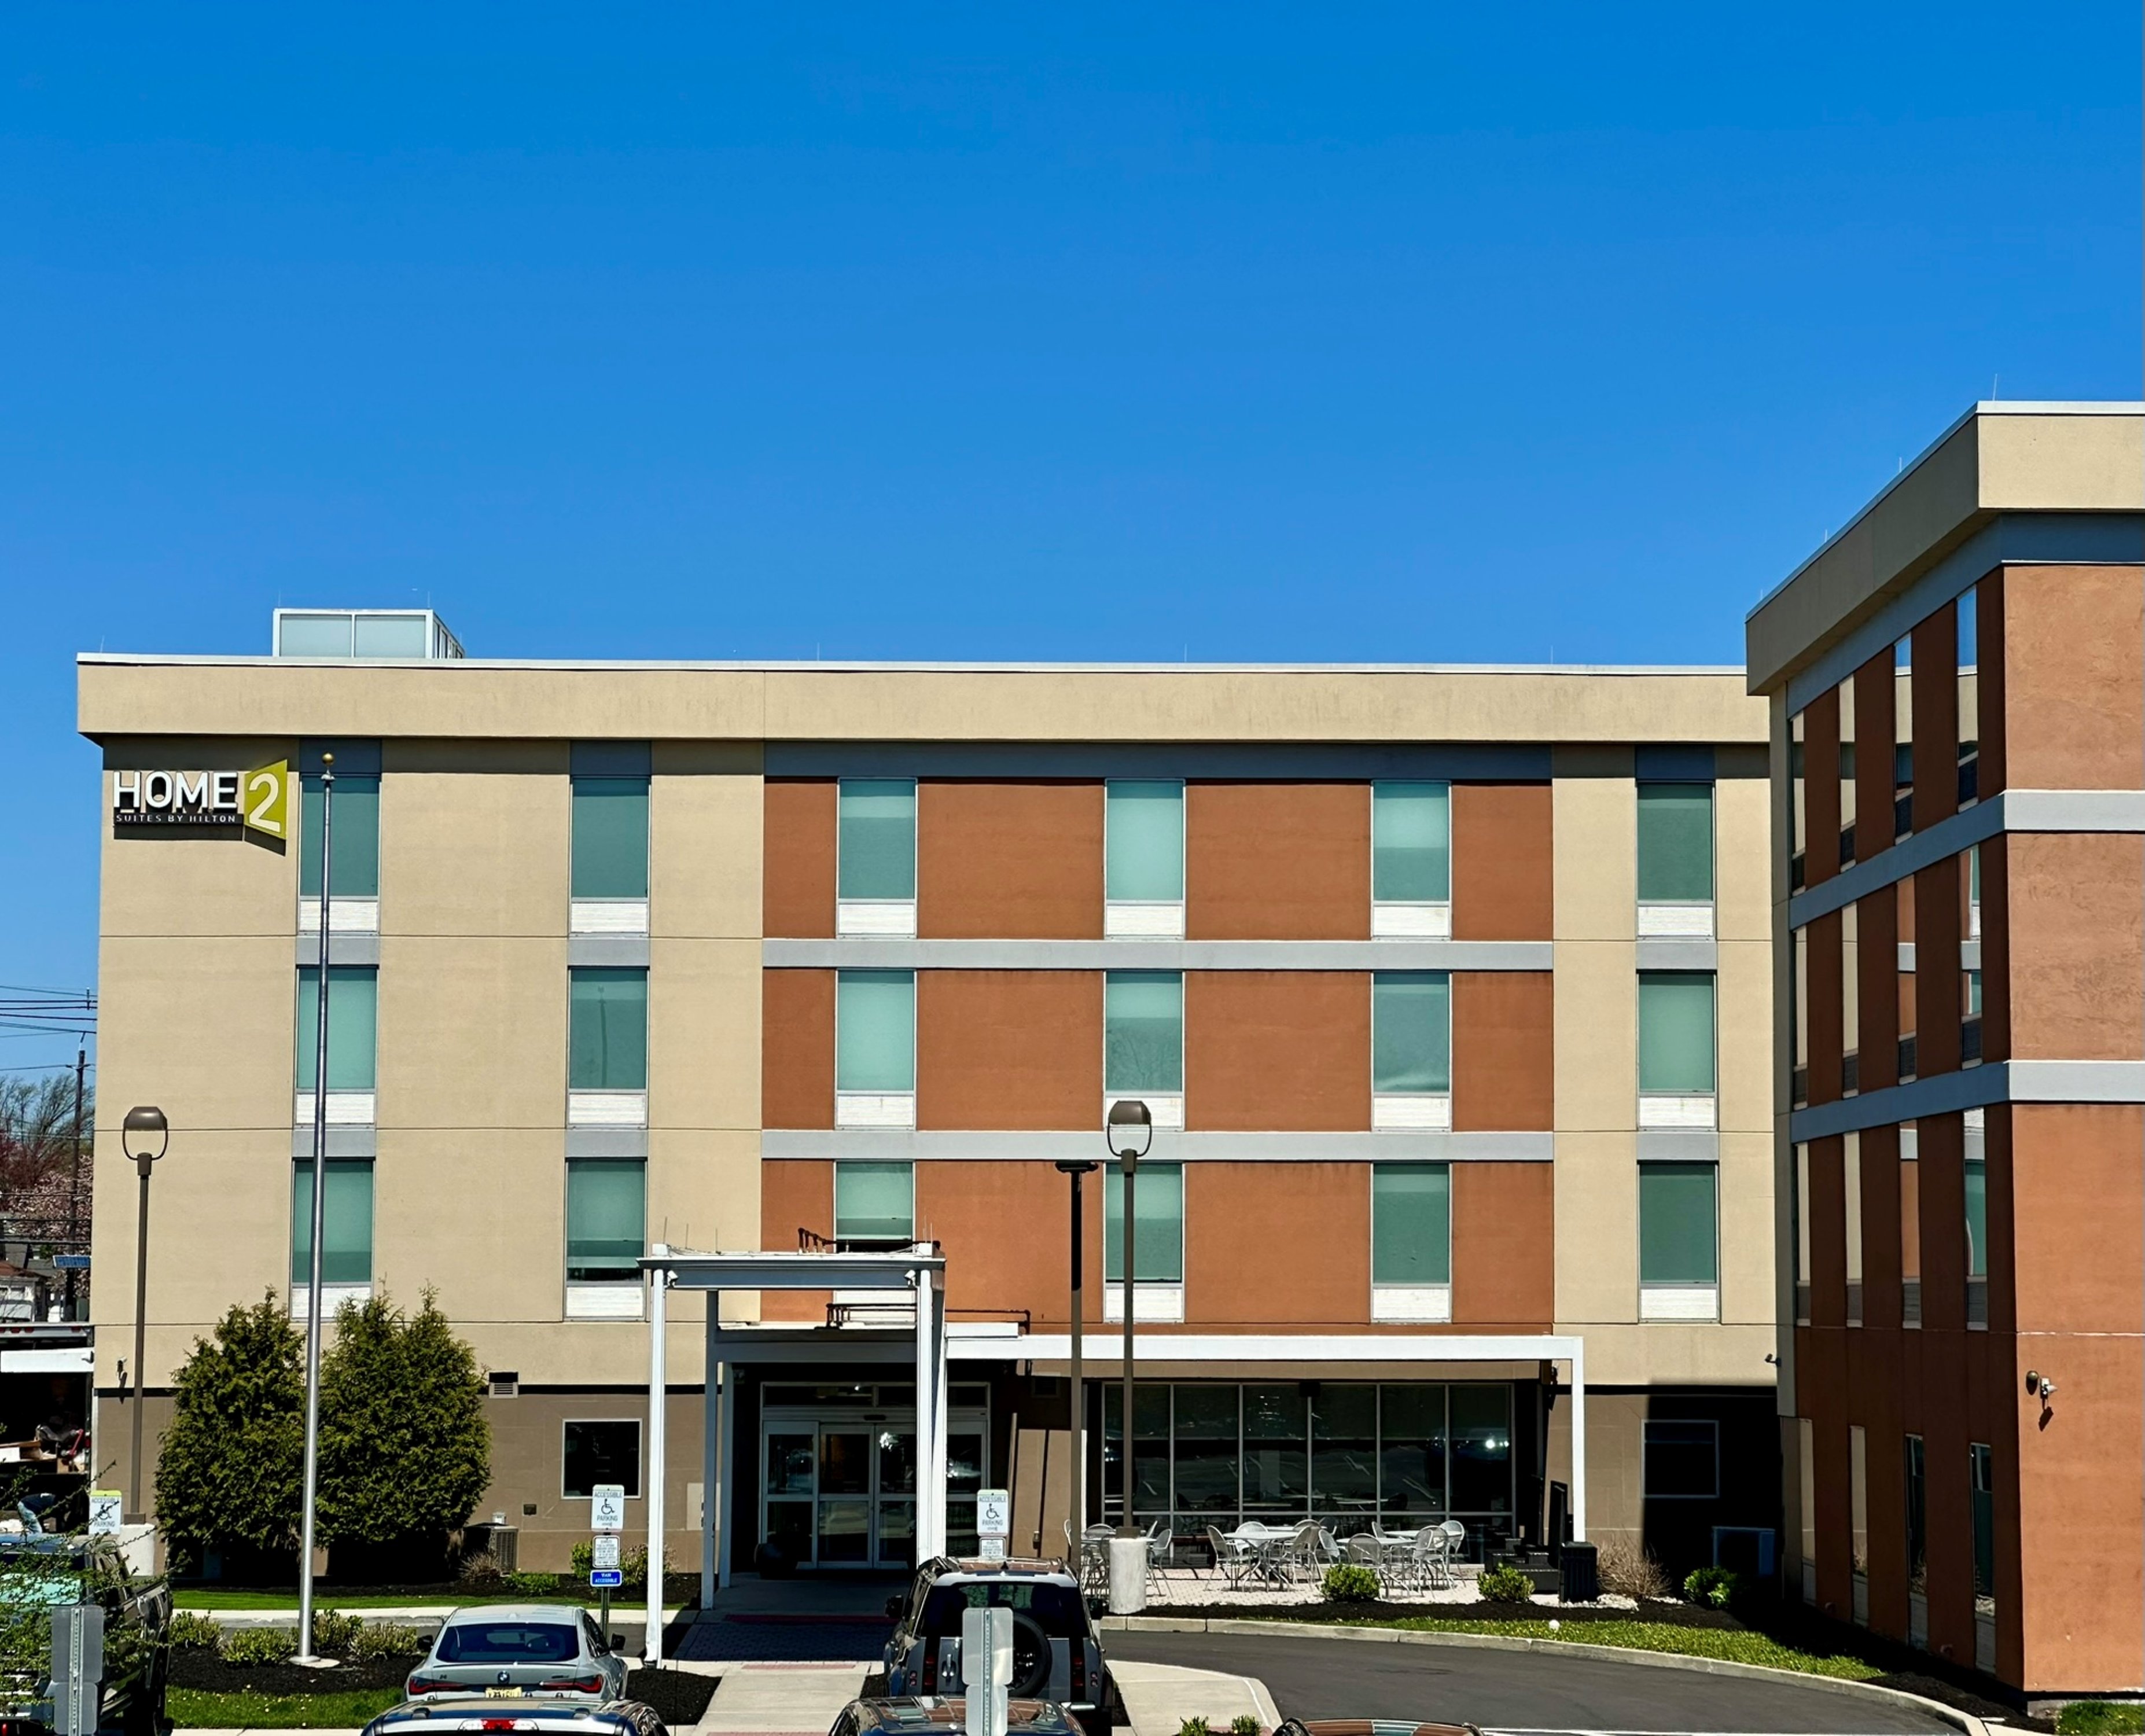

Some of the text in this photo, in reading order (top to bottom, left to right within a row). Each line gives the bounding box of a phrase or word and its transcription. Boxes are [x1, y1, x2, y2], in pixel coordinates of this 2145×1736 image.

[113, 771, 281, 833] HOME 2
[116, 814, 236, 822] SUITES BY HILTON
